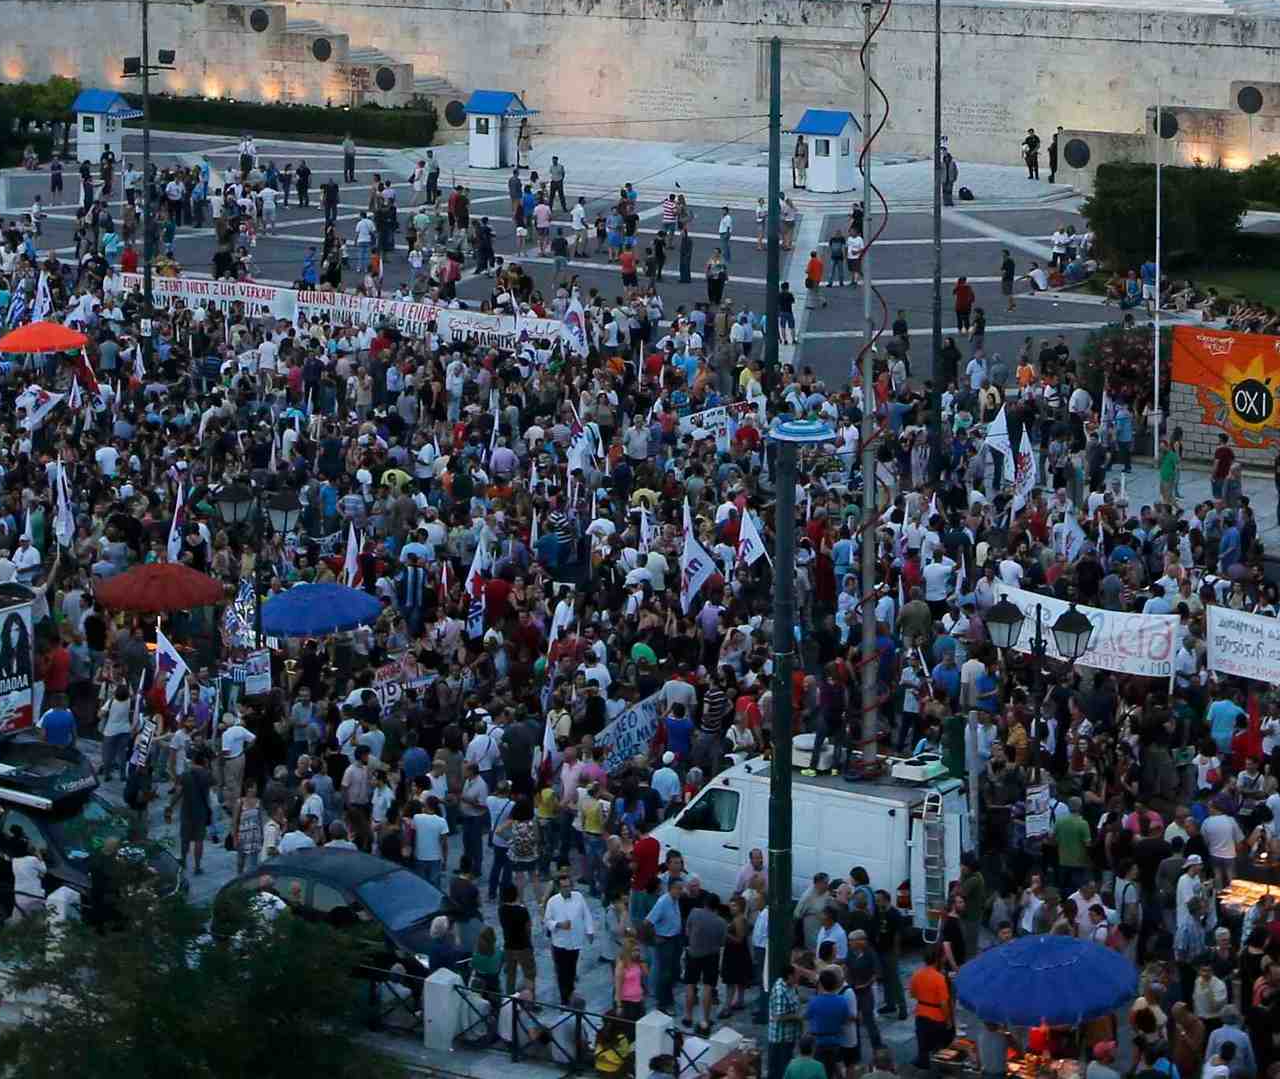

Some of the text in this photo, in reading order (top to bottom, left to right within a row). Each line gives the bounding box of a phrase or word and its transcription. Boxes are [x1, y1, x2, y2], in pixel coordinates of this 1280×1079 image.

[213, 283, 236, 296] ZUM
[239, 286, 277, 301] VERKAUF
[1235, 390, 1267, 417] ΟΧΙ
